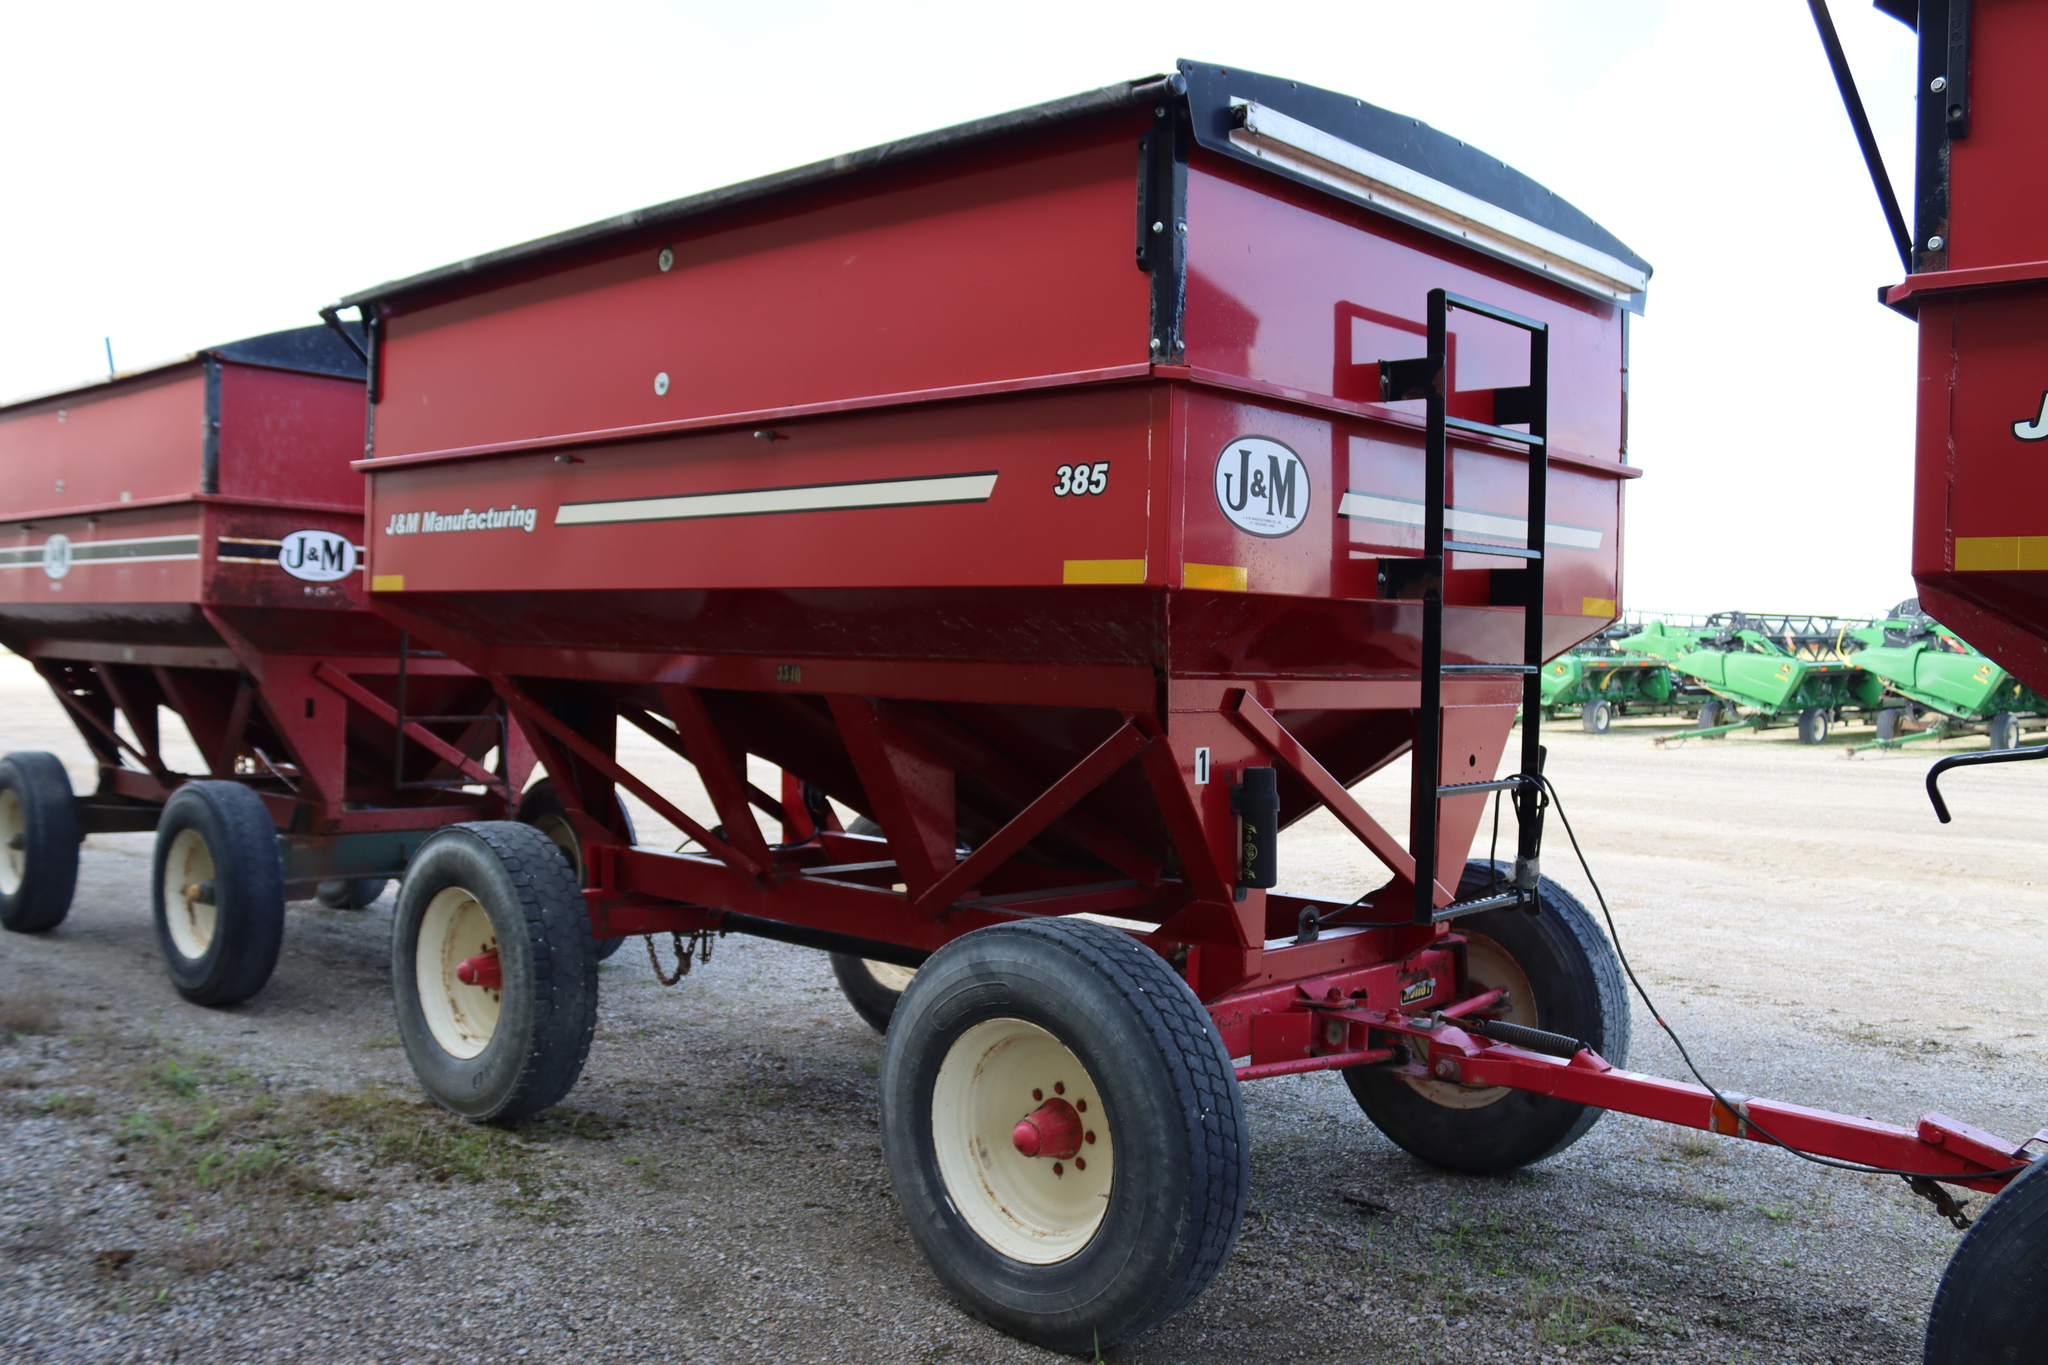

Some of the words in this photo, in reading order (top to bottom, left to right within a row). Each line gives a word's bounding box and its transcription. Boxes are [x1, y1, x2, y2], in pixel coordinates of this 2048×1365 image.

[1053, 461, 1110, 497] 385
[1224, 448, 1298, 519] J&M
[385, 513, 420, 536] J&M
[421, 504, 537, 532] Manufacturing
[285, 536, 345, 572] J&M
[1199, 750, 1206, 781] 1
